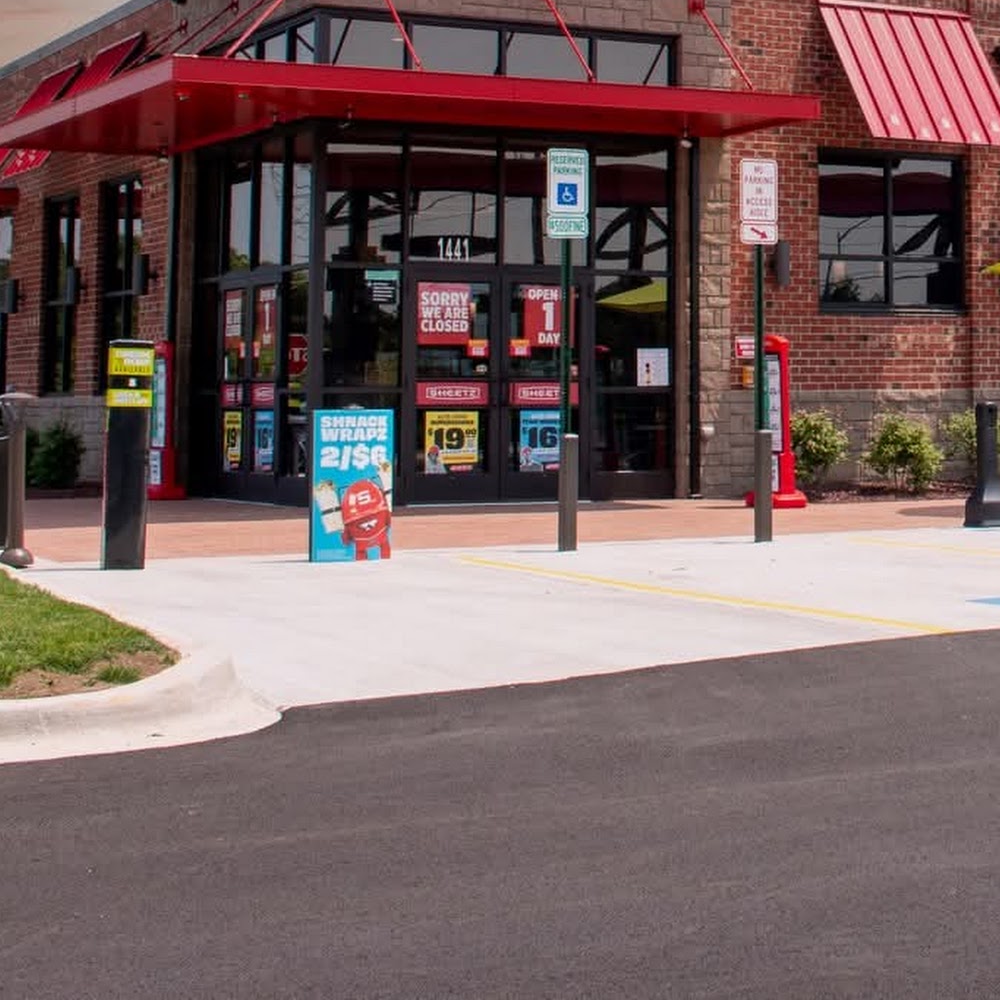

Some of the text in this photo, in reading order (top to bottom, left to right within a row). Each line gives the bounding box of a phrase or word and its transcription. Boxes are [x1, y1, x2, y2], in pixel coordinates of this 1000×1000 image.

[438, 237, 470, 262] 1441
[420, 292, 469, 306] SORRY
[527, 288, 558, 301] OPEN
[421, 307, 469, 320] WE ARE
[542, 302, 555, 331] 1
[420, 320, 469, 333] CLOSED
[537, 333, 562, 345] DAY
[429, 387, 476, 398] SHEETZ
[522, 387, 561, 398] SHEET
[320, 415, 388, 428] SHNACK
[320, 428, 389, 442] WRAPZ
[320, 443, 388, 471] 2/$6
